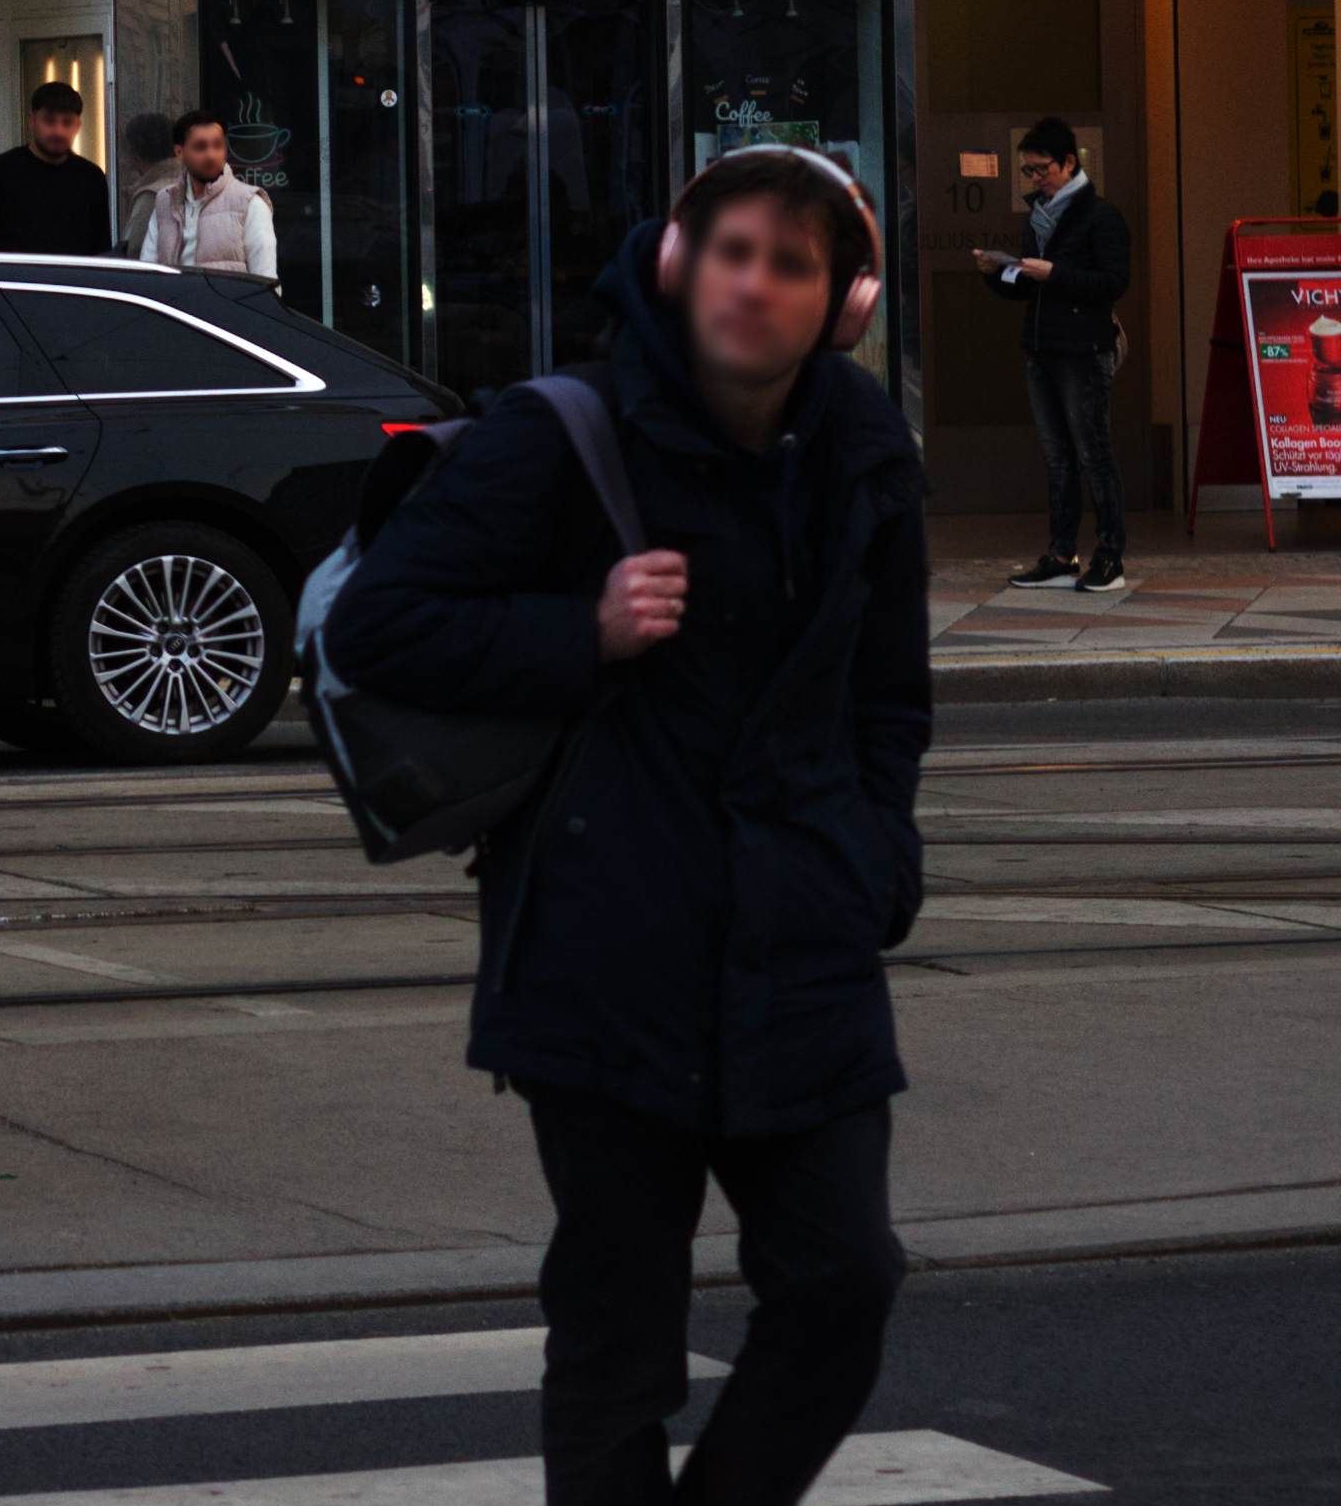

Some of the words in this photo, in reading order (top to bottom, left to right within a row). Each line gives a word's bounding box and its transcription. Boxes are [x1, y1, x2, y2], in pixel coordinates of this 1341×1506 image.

[715, 99, 774, 128] Coffee
[234, 166, 290, 189] offee
[945, 182, 984, 214] 10
[920, 233, 976, 250] JULIUS
[1291, 288, 1341, 306] VICH
[1269, 414, 1287, 424] NEU
[1269, 424, 1310, 433] COLLAGEN
[1271, 437, 1317, 451] Kollagen
[1319, 436, 1341, 448] Boo
[1272, 449, 1306, 461] Schützt
[1308, 451, 1323, 460] vor
[1274, 461, 1338, 475] UV-Strahlung.
